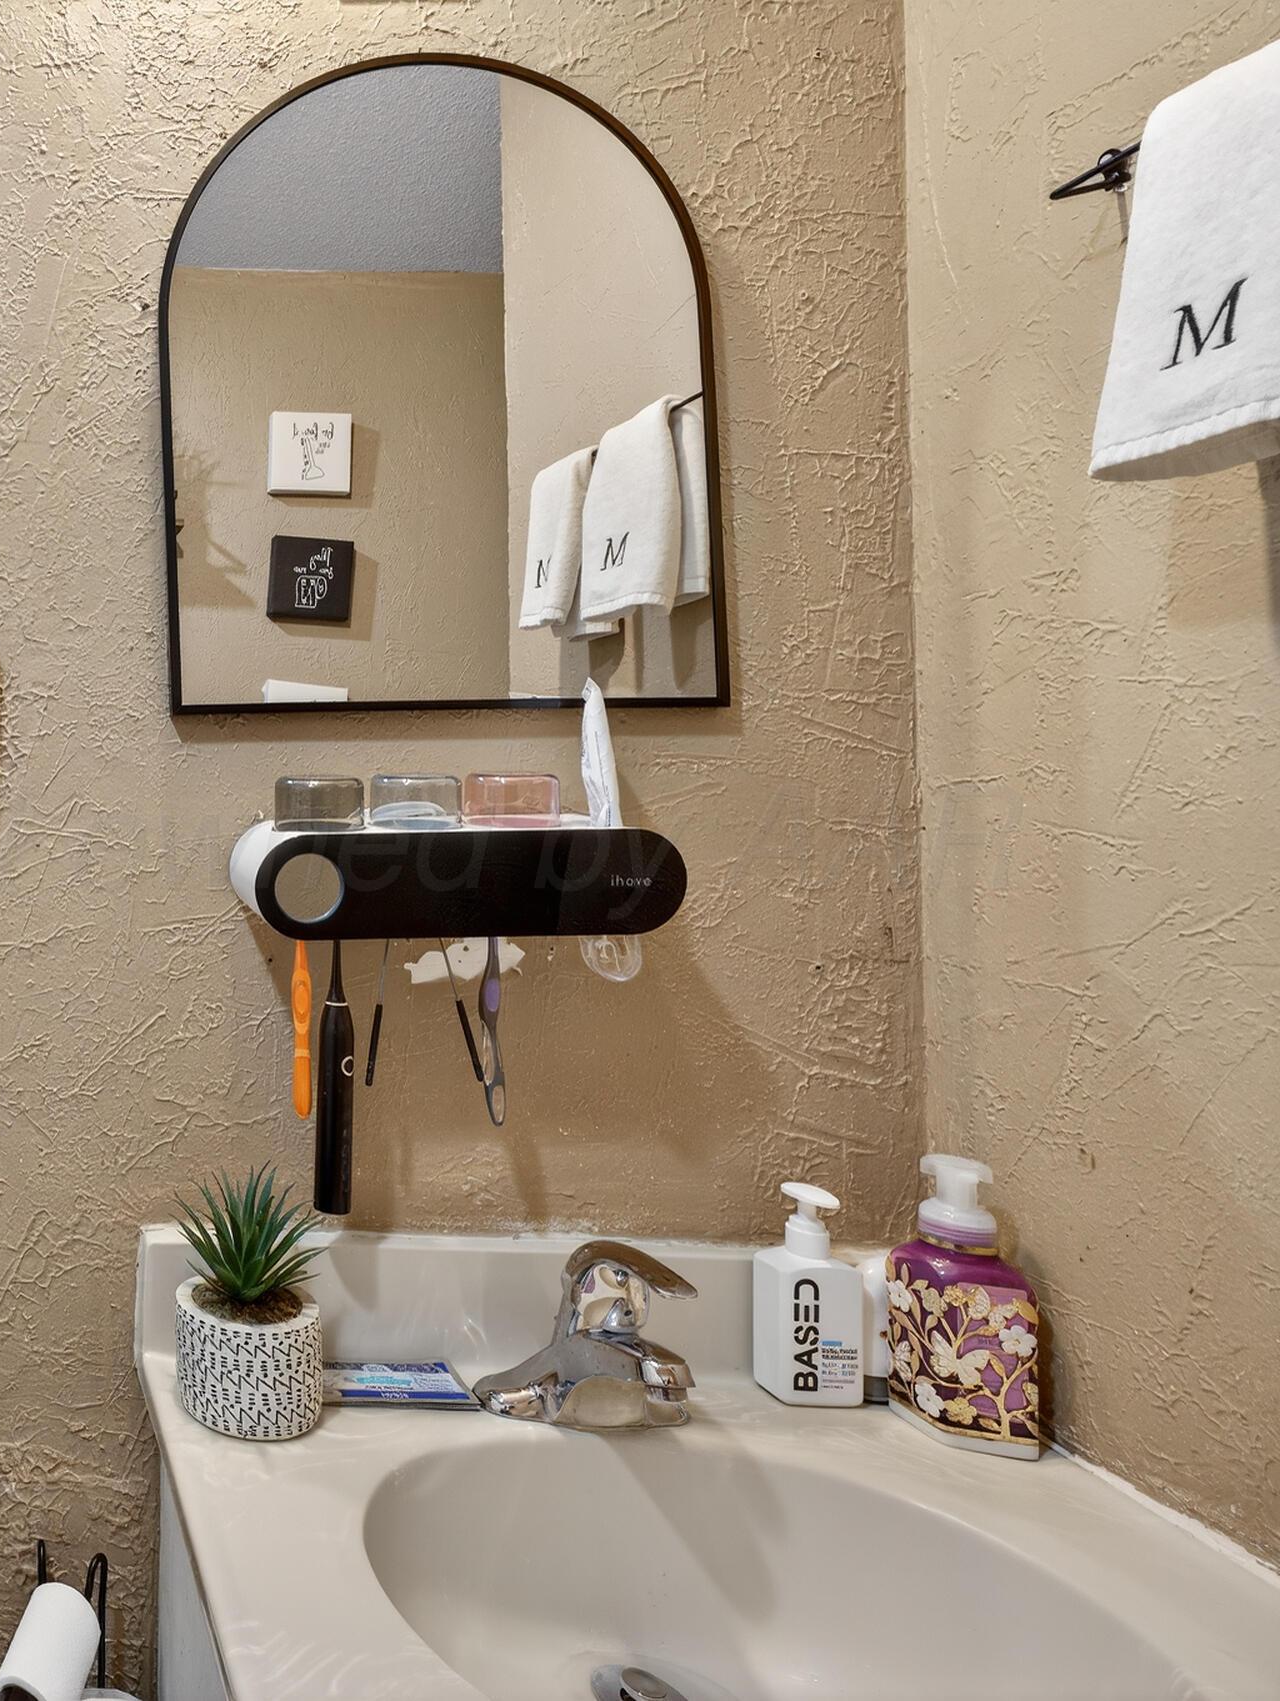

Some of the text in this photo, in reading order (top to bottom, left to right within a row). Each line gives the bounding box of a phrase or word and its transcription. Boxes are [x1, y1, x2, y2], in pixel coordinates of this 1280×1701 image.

[1160, 278, 1248, 371] M
[610, 874, 653, 887] ihove
[793, 1278, 821, 1392] BASED
